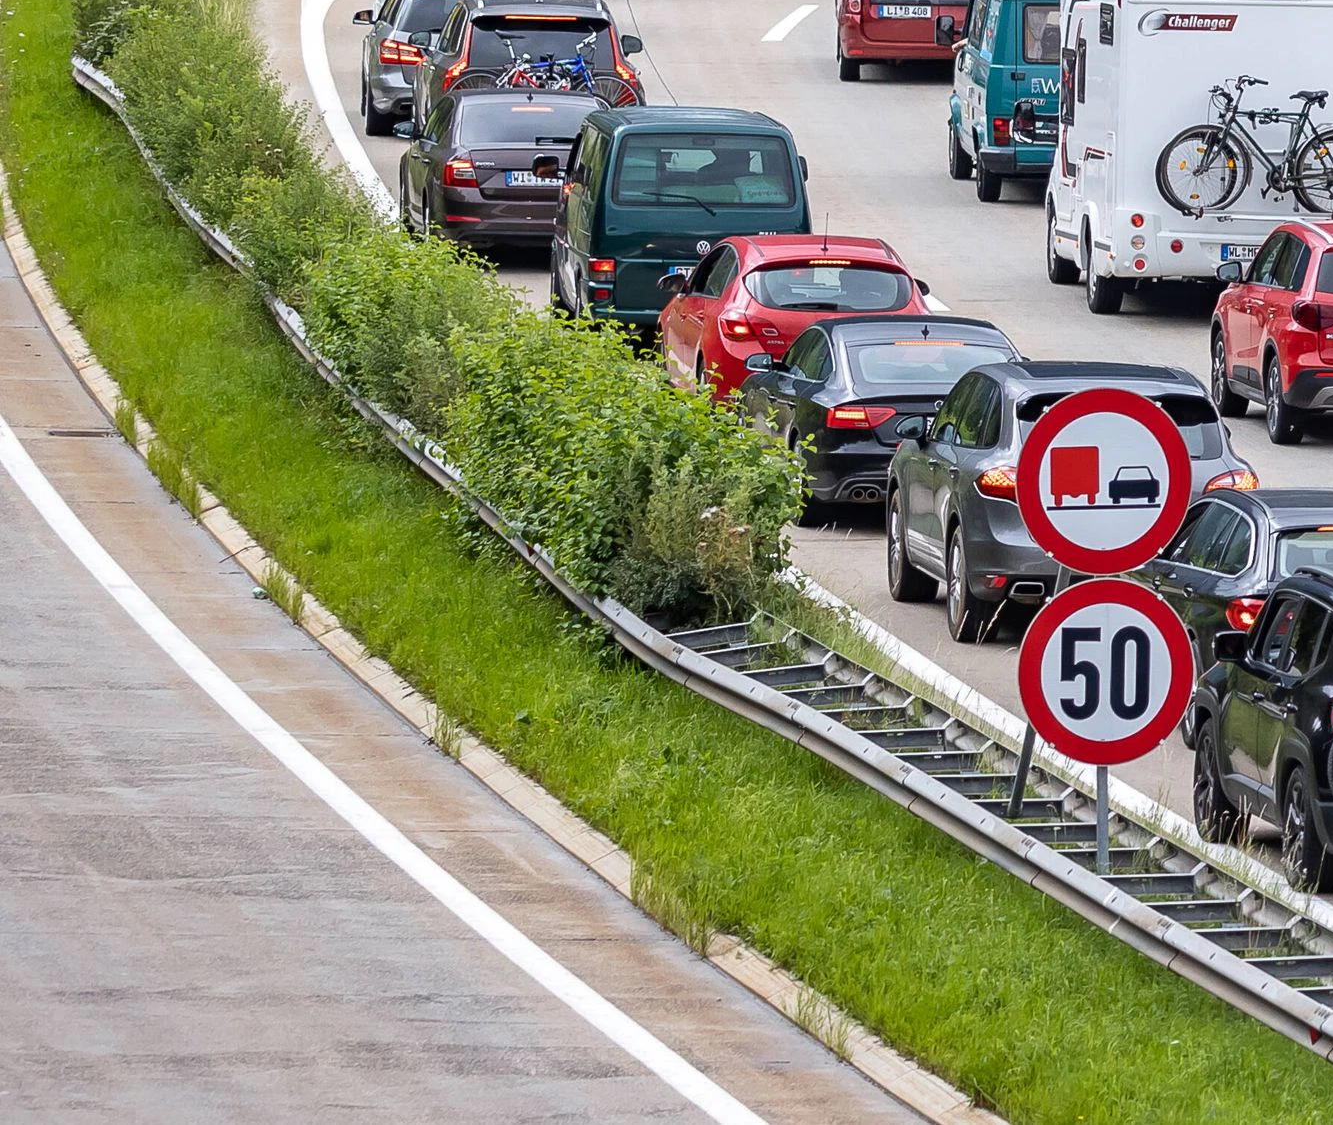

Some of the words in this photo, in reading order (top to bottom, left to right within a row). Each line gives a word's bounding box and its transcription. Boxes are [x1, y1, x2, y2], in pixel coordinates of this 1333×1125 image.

[887, 6, 898, 15] LI
[904, 6, 910, 15] B
[912, 6, 928, 16] 408
[1168, 15, 1231, 31] Challenger
[1228, 246, 1241, 258] WL
[1060, 625, 1151, 720] 50
